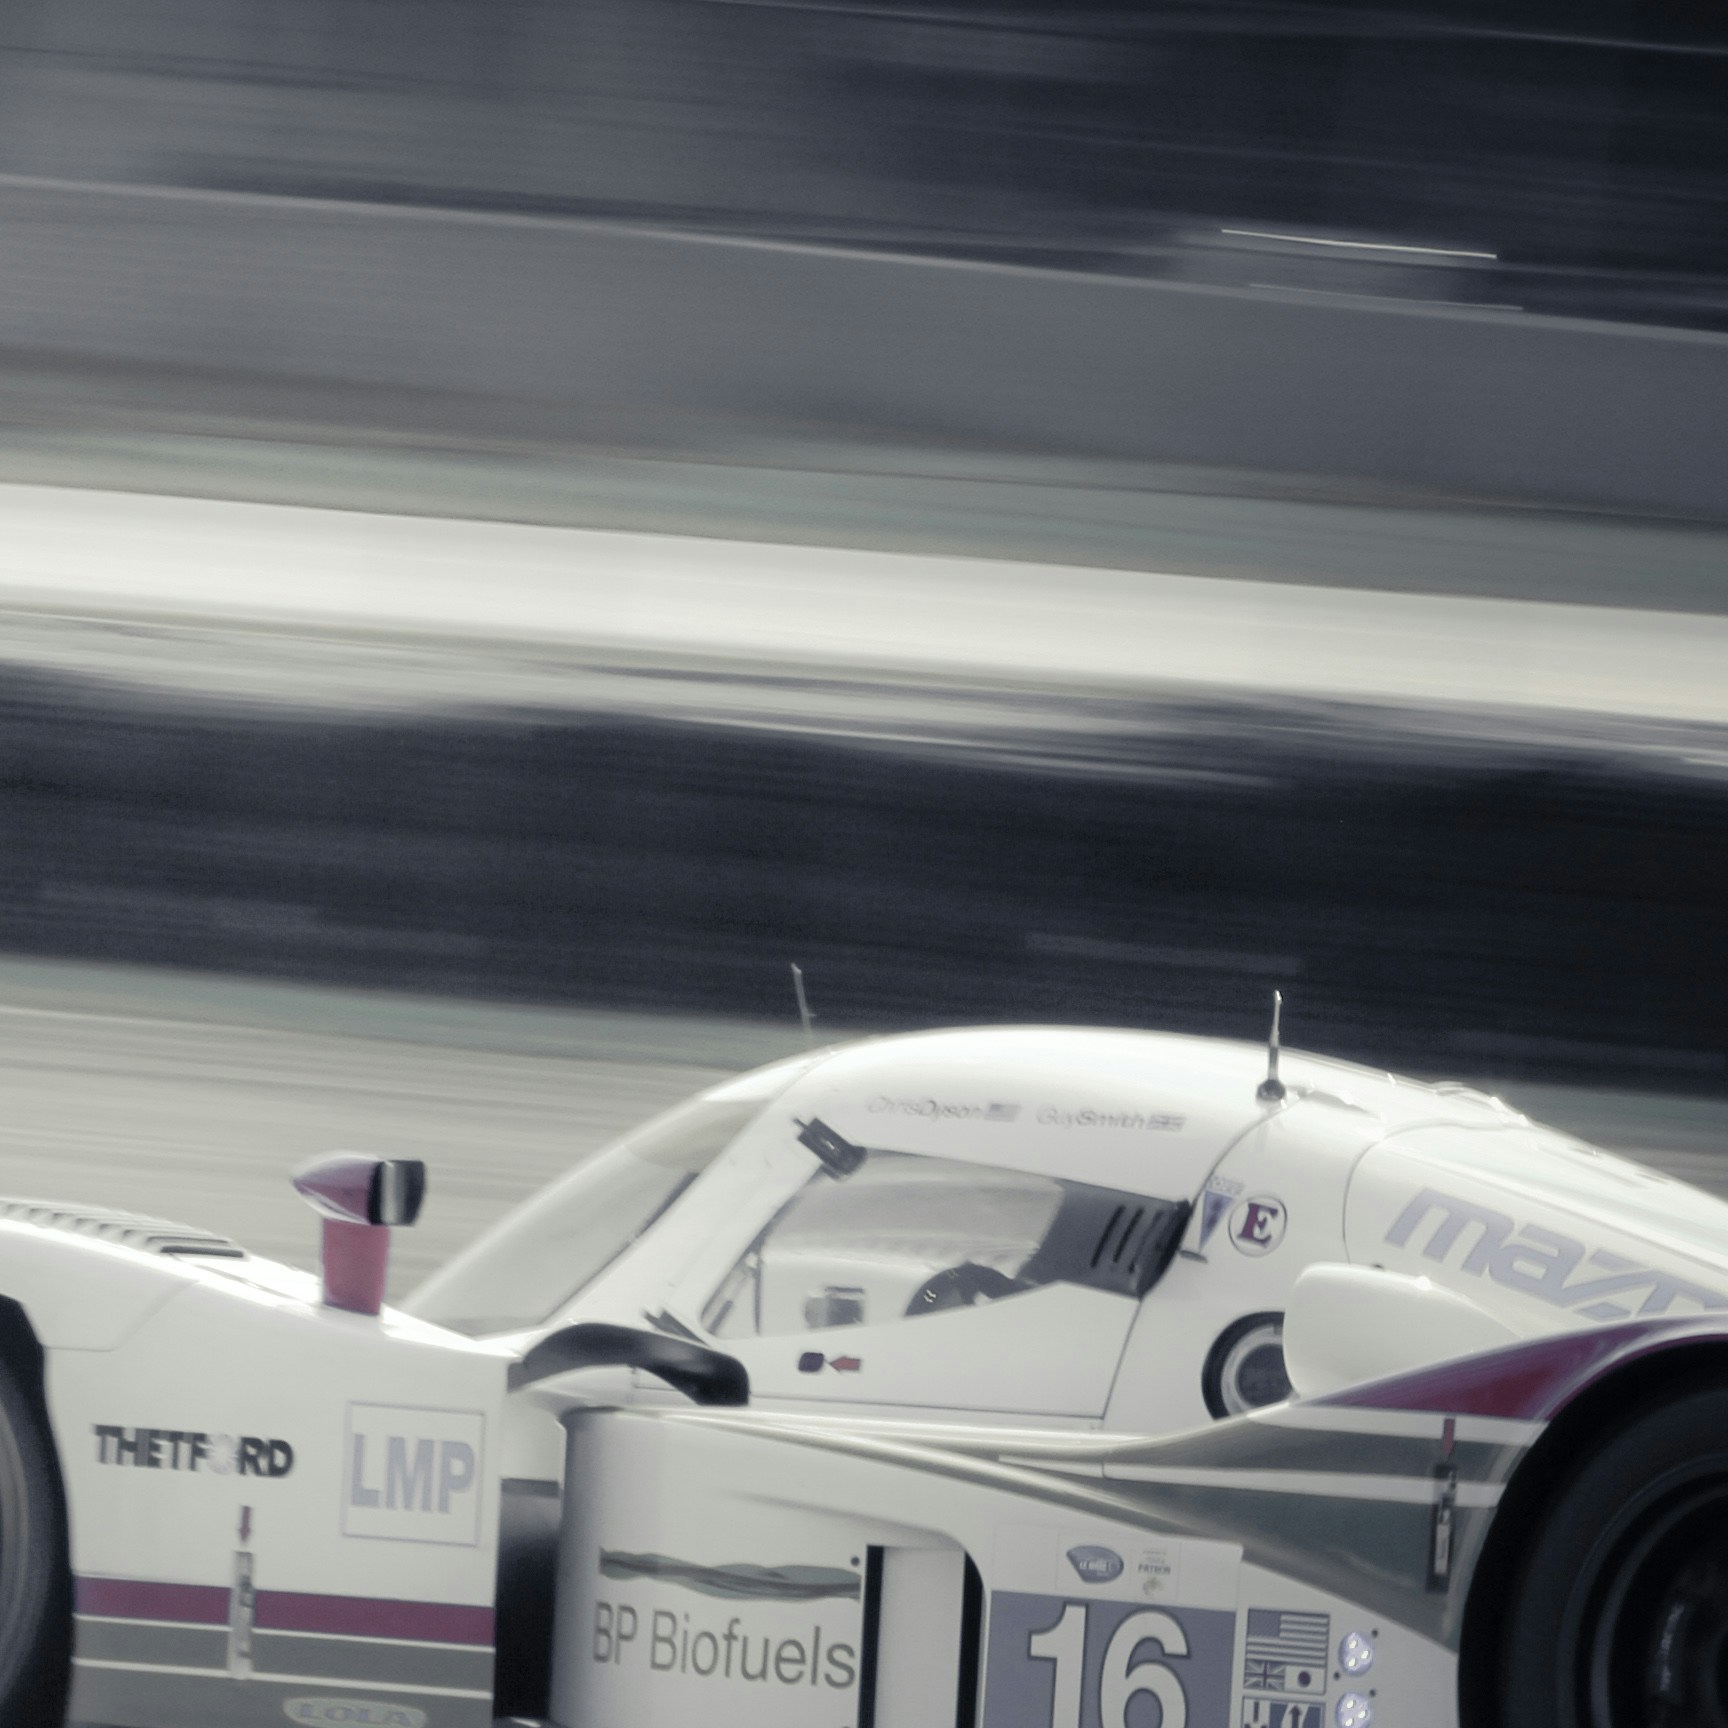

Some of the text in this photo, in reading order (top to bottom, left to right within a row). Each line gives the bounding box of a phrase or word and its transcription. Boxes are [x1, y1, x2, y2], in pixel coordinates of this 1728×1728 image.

[1237, 1203, 1278, 1248] E
[349, 1433, 474, 1514] LMP
[592, 1601, 856, 1689] BP Biofuels
[299, 1703, 412, 1728] LOLA
